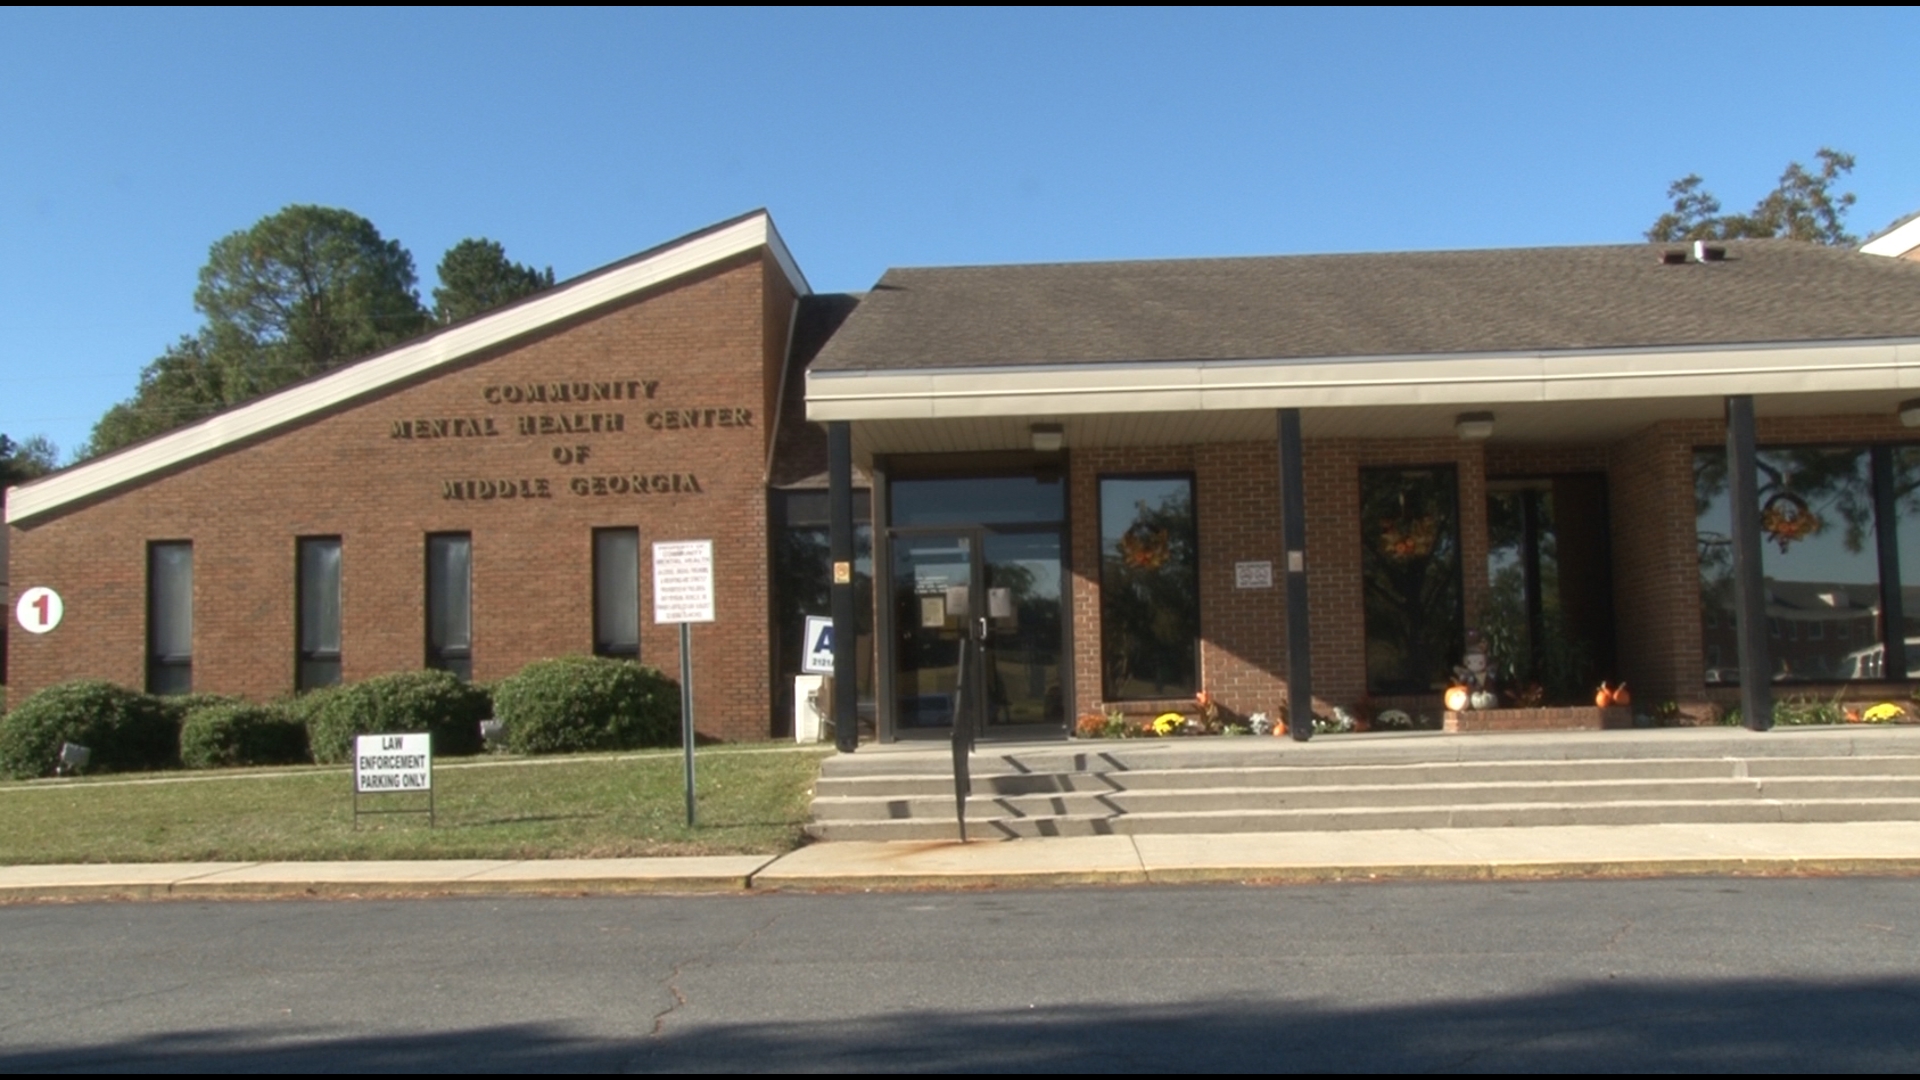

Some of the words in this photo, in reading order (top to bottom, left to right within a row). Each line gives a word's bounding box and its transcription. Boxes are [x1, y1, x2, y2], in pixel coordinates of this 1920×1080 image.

[482, 380, 660, 404] COMMUNITY
[389, 417, 499, 439] MENTAL
[516, 412, 625, 435] HEALTH
[644, 407, 753, 430] CENTER
[551, 445, 591, 464] OF
[441, 478, 552, 500] MIDDLE
[568, 472, 703, 496] GEORGIA
[31, 594, 49, 625] 1
[381, 736, 403, 750] LAW
[360, 754, 425, 770] ENFORCEMENT
[360, 774, 400, 788] PARKING
[402, 773, 427, 787] ONLY
